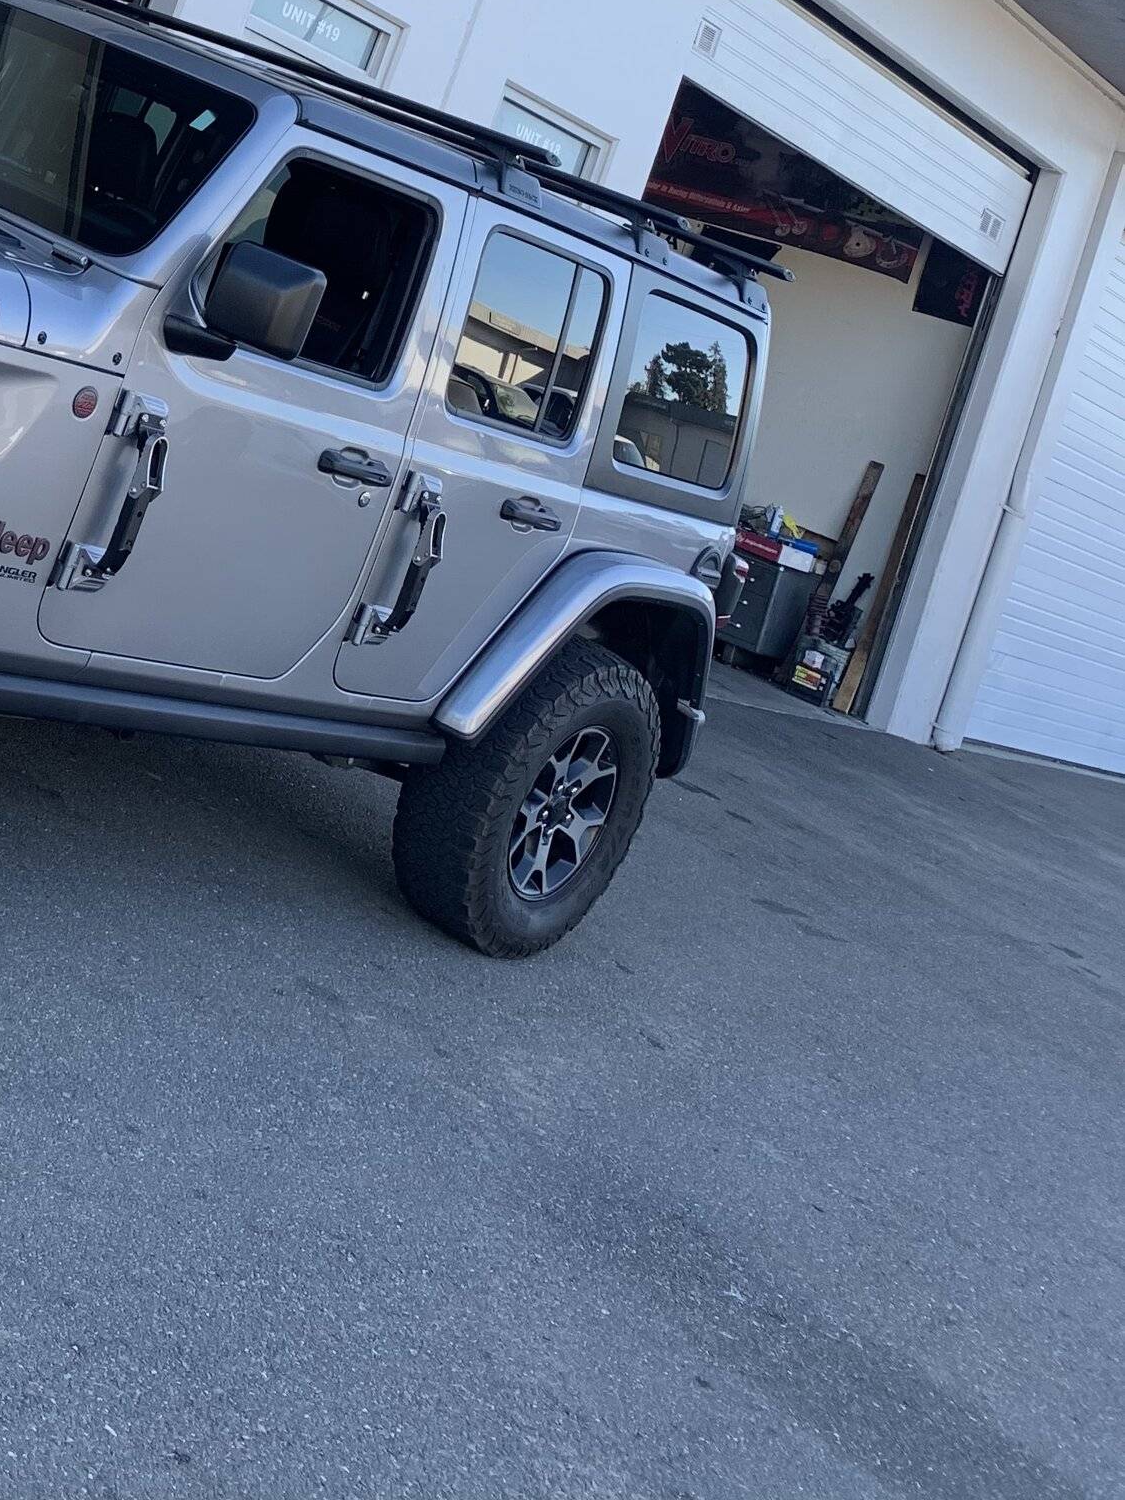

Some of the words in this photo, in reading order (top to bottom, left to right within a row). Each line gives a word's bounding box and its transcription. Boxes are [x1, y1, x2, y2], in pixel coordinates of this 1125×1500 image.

[282, 1, 316, 28] UNIT
[316, 19, 340, 41] #19
[516, 123, 541, 145] UNIT
